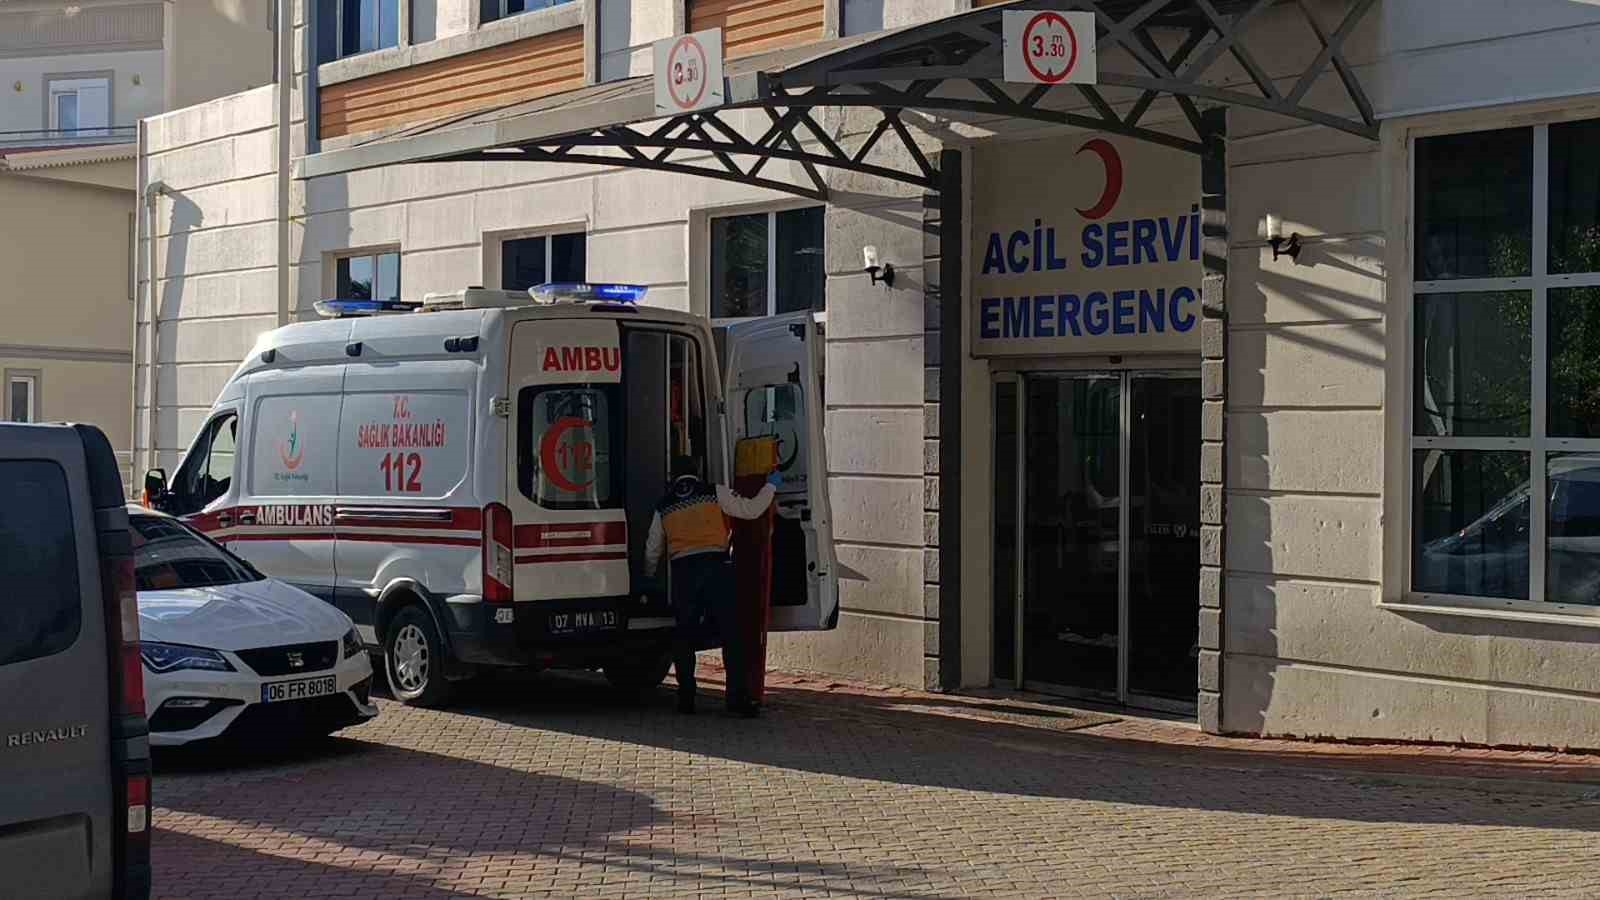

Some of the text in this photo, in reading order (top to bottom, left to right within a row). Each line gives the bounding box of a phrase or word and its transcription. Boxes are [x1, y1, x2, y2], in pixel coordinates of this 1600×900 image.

[1032, 35, 1065, 57] 3.30
[982, 203, 1200, 275] ACİL SERVİ
[979, 286, 1202, 340] EMERGENC
[542, 346, 620, 372] AMBU
[358, 418, 446, 449] SAĞLIK BAKANLIĞI
[380, 452, 422, 492] 112
[256, 504, 332, 526] AMBULANS
[269, 684, 285, 700] 06
[288, 681, 306, 698] FR
[7, 723, 88, 747] RENAULT
